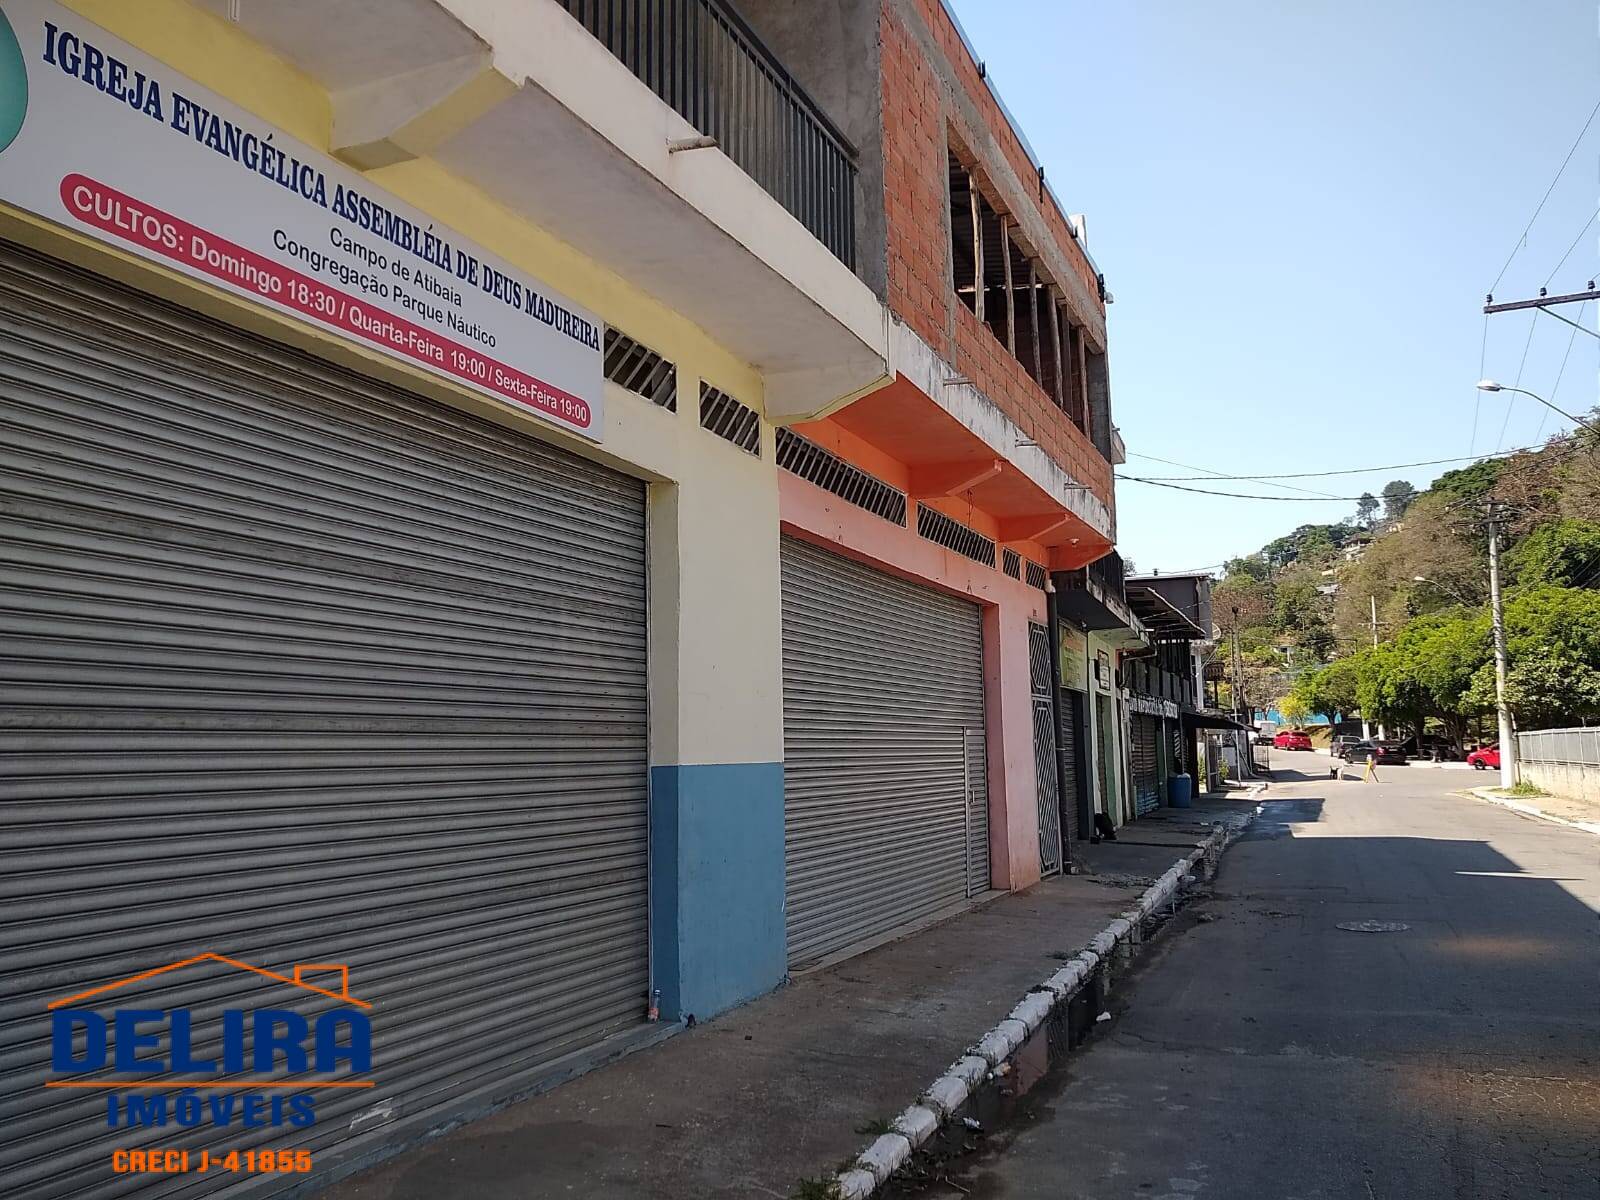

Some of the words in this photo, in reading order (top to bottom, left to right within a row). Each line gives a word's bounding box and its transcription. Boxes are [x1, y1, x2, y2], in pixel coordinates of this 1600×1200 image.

[43, 20, 164, 122] IGREJA
[170, 91, 327, 208] EVANGÉLICA
[331, 183, 452, 274] ASSEMBLÉIA
[456, 249, 478, 286] DE
[482, 263, 522, 310] DEUS
[524, 287, 600, 351] MADUREIRA
[330, 227, 387, 271] Campo
[391, 260, 410, 280] de
[413, 270, 462, 307] Atibaia
[73, 185, 185, 252] CULTOS:
[191, 235, 282, 293] Domingo
[287, 279, 336, 317] 18:30
[349, 306, 444, 362] Quarta-Feira
[450, 350, 486, 379] 19:00
[495, 367, 558, 410] Sexta-Feira
[559, 396, 588, 422] 19:00
[273, 229, 389, 299] Congregação
[393, 285, 443, 323] Parque
[447, 310, 496, 348] Náutico
